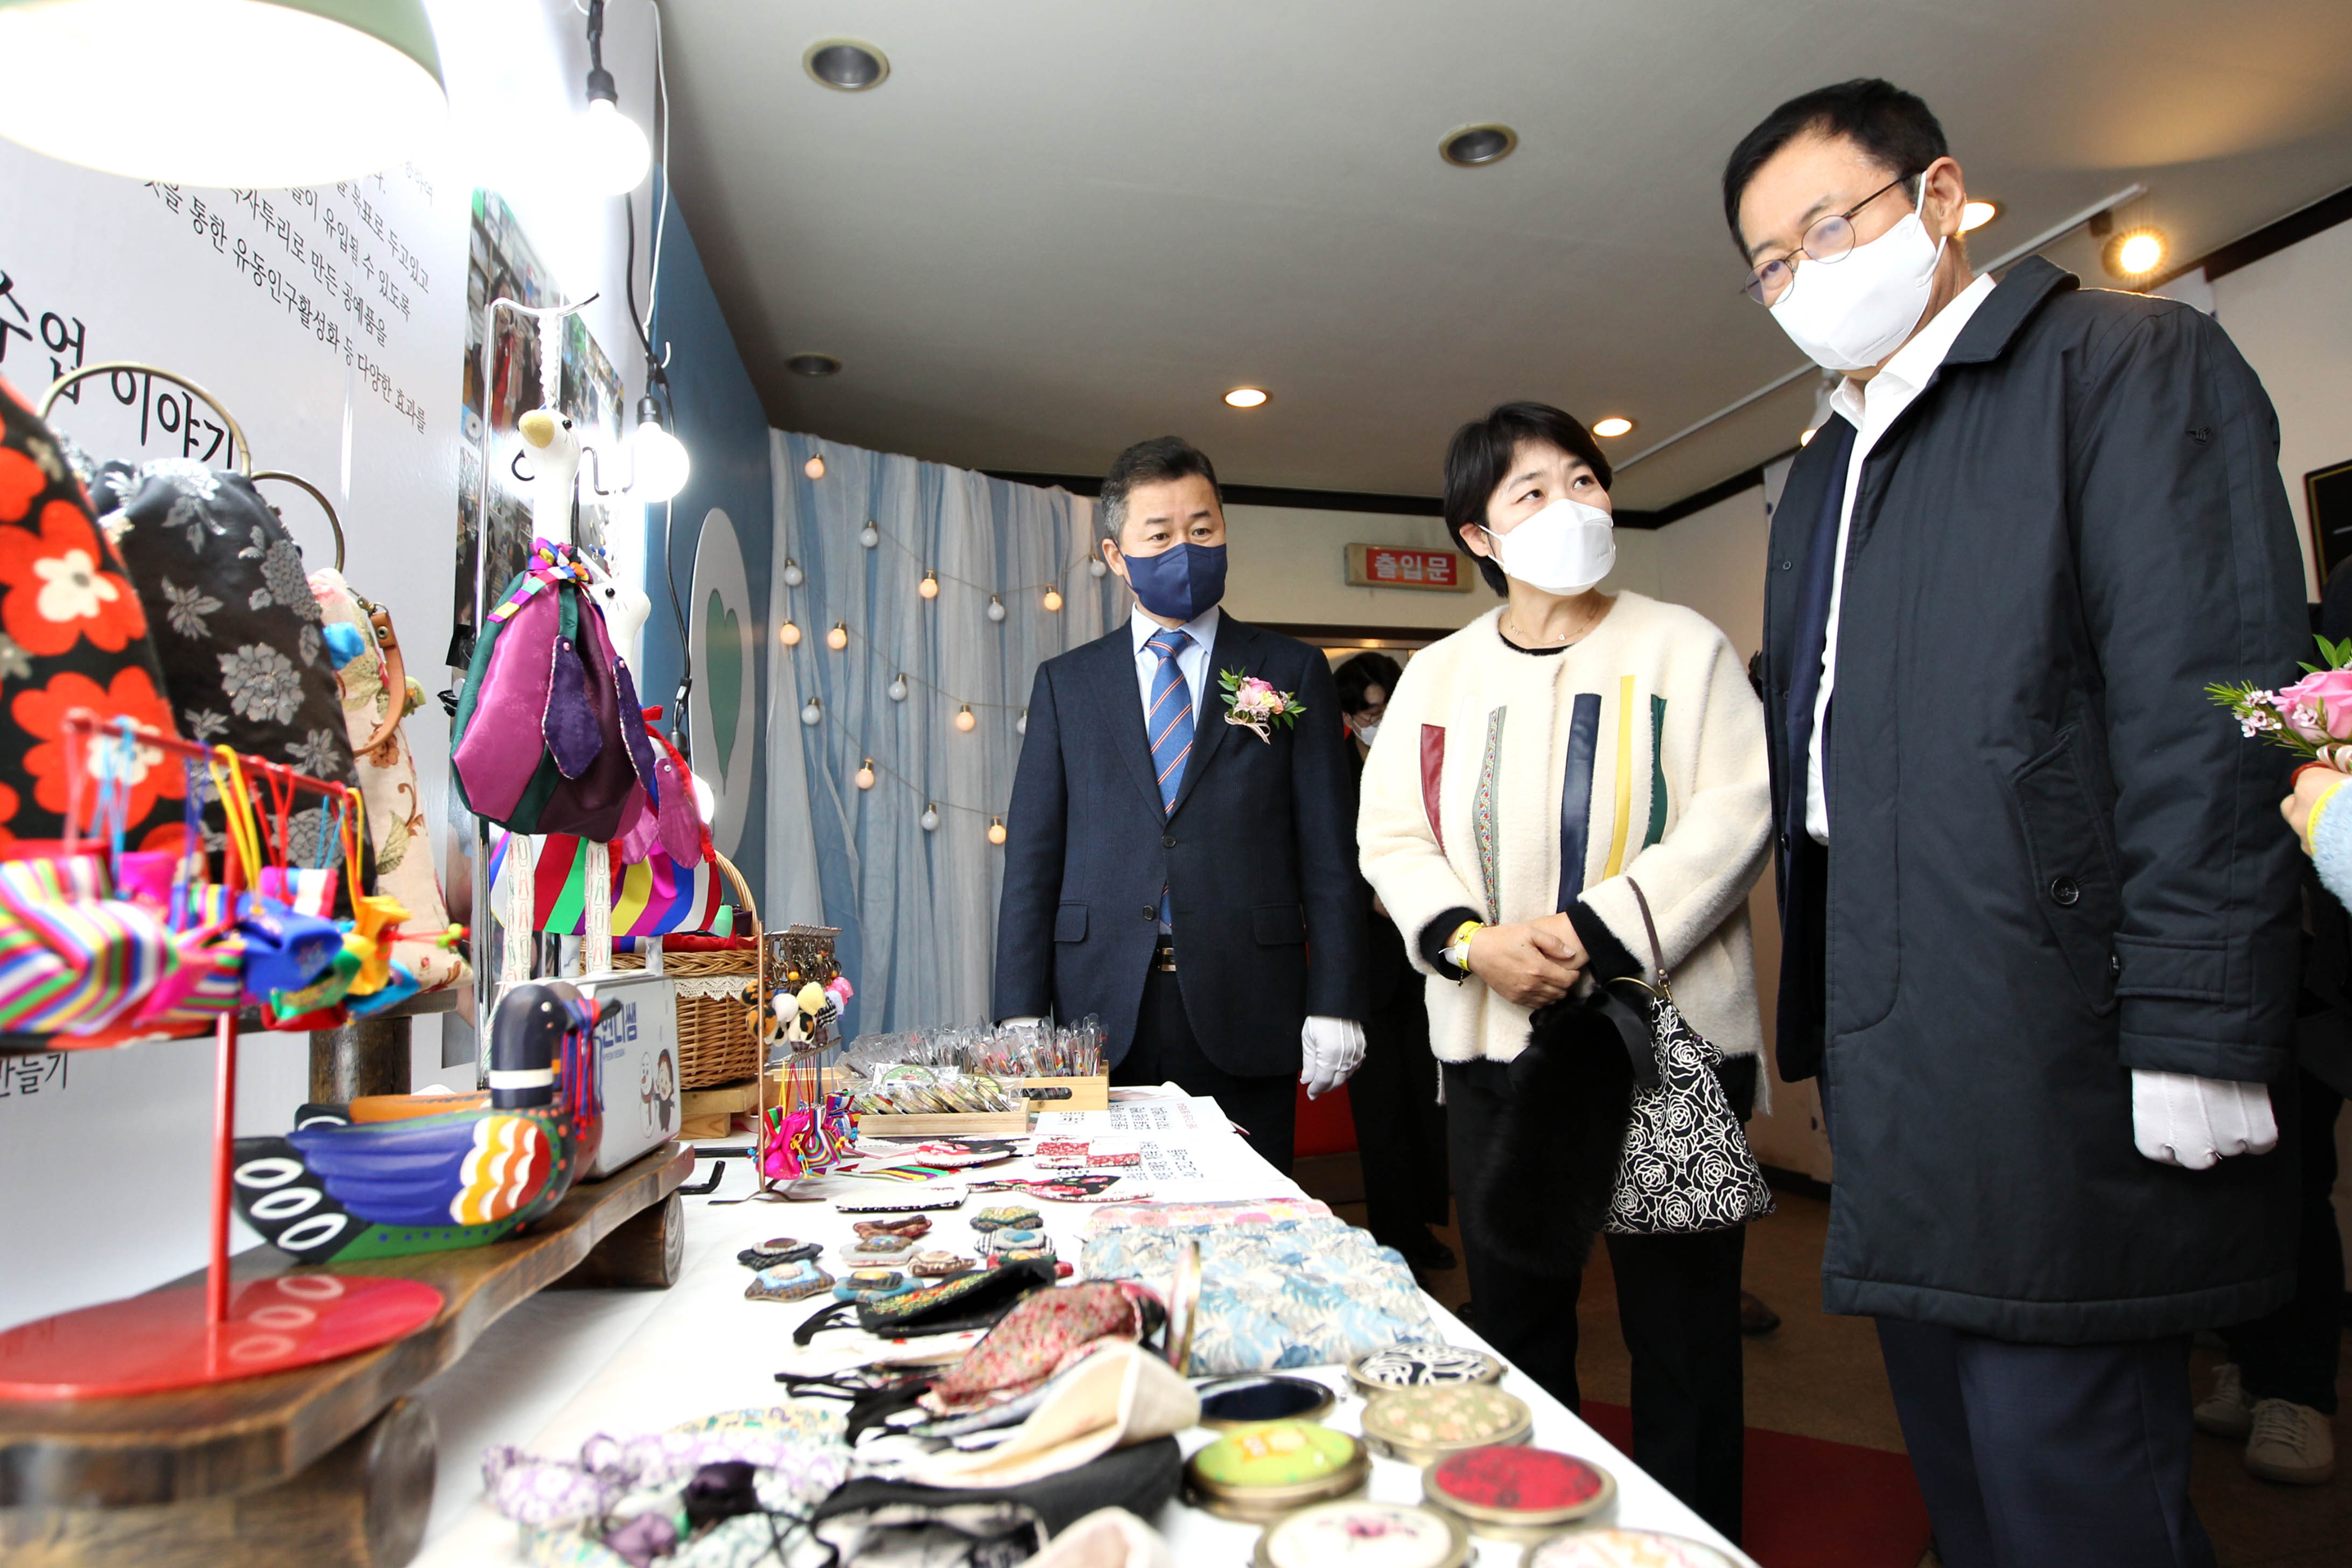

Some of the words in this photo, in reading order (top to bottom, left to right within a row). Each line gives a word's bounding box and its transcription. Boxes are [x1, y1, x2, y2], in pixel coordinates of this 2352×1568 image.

[323, 208, 359, 267] 유입될
[362, 253, 375, 281] 수
[379, 270, 410, 323] 있도록
[352, 183, 384, 242] 목표로
[388, 229, 429, 293] 두고있고
[189, 195, 228, 254] 통한
[232, 238, 340, 354] 유동인구활성화
[344, 335, 354, 366] 등
[357, 353, 393, 403] 다양한
[395, 388, 426, 435] 효과를
[311, 250, 338, 297] 만든
[342, 281, 387, 348] 공예품을
[111, 370, 234, 470] 이야기
[1374, 552, 1450, 582] 출입문
